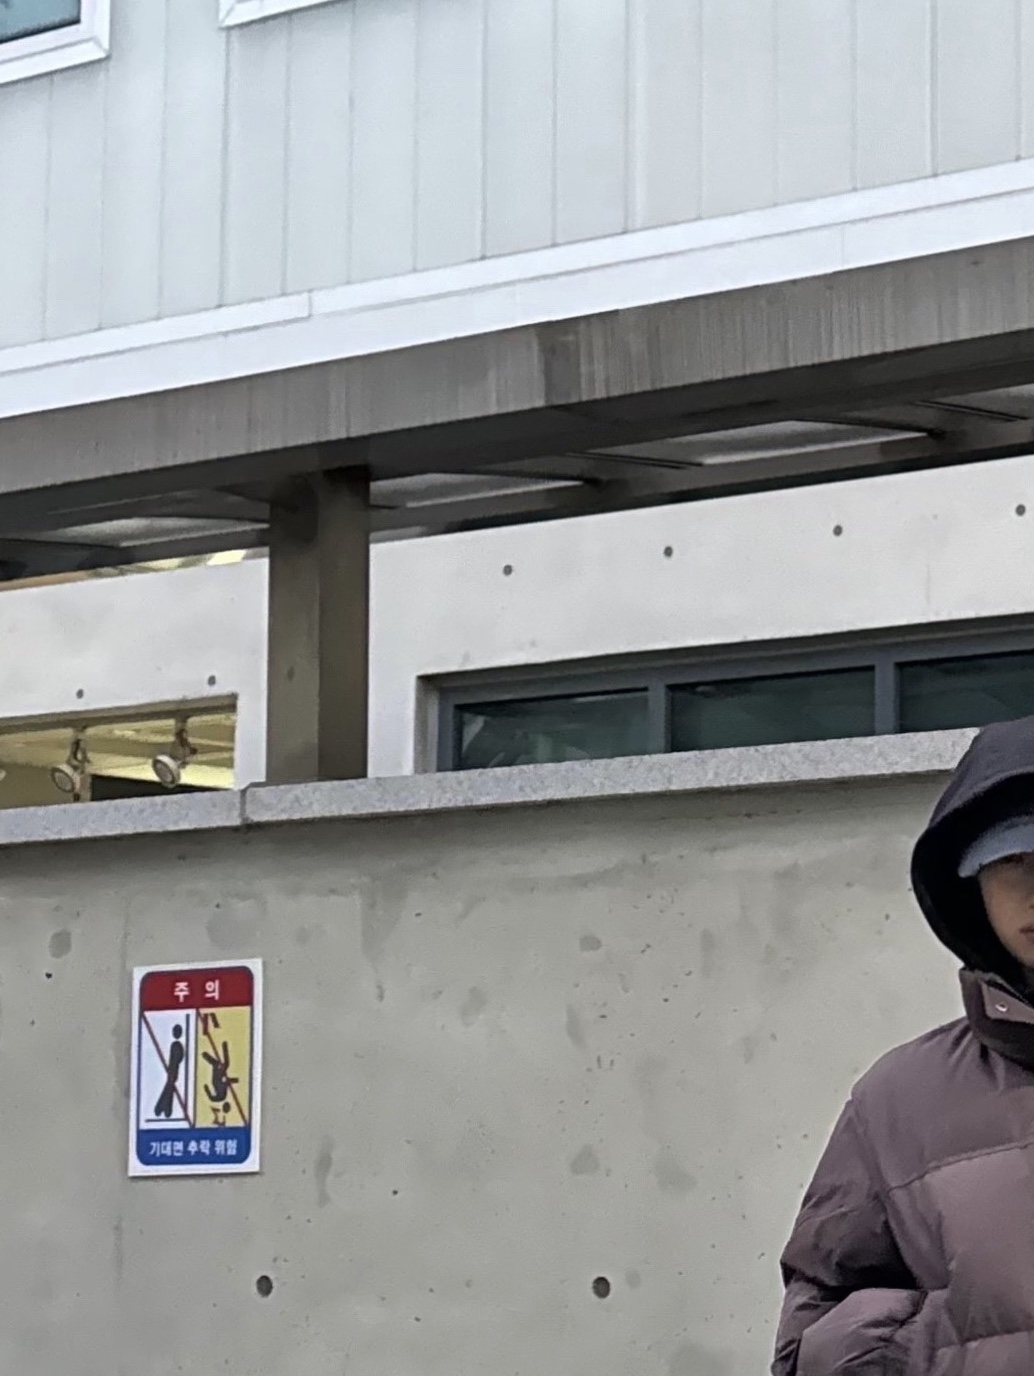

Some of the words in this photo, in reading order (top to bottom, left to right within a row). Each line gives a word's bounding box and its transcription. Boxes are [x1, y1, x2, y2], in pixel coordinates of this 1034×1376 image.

[149, 1141, 184, 1157] 기대면
[187, 1140, 211, 1155] 추락
[214, 1139, 238, 1156] 위험
